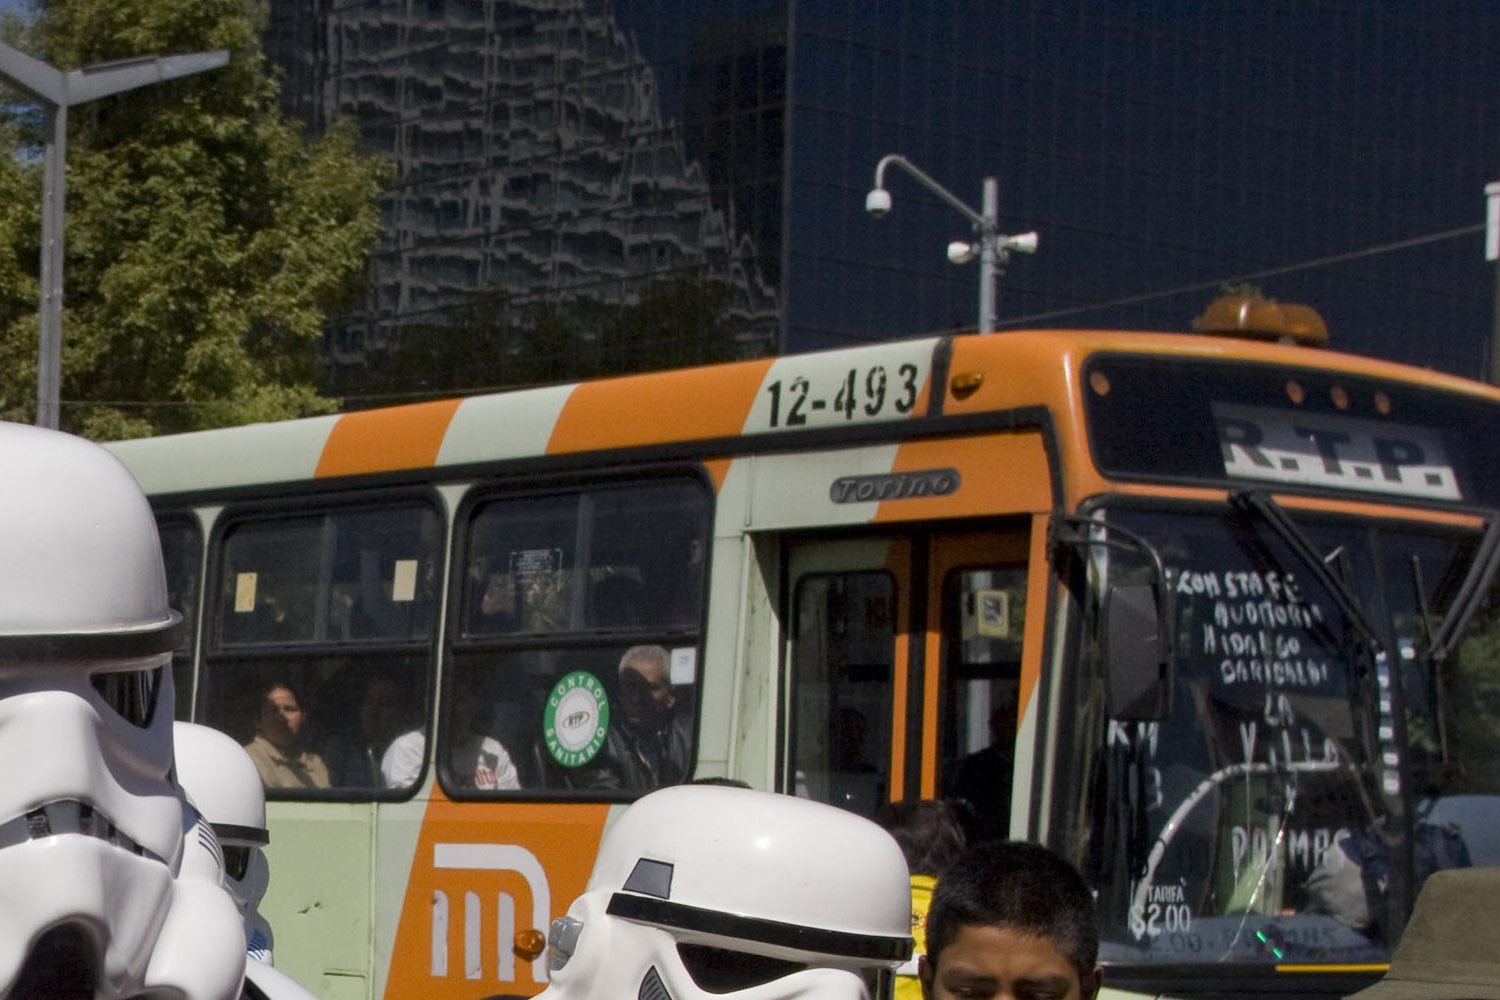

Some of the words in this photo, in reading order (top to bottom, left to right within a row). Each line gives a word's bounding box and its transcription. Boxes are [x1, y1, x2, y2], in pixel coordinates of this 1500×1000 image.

[767, 362, 918, 428] 12-493
[840, 474, 952, 499] Torino
[550, 675, 606, 711] CONTROL
[546, 727, 605, 765] SANITARIO
